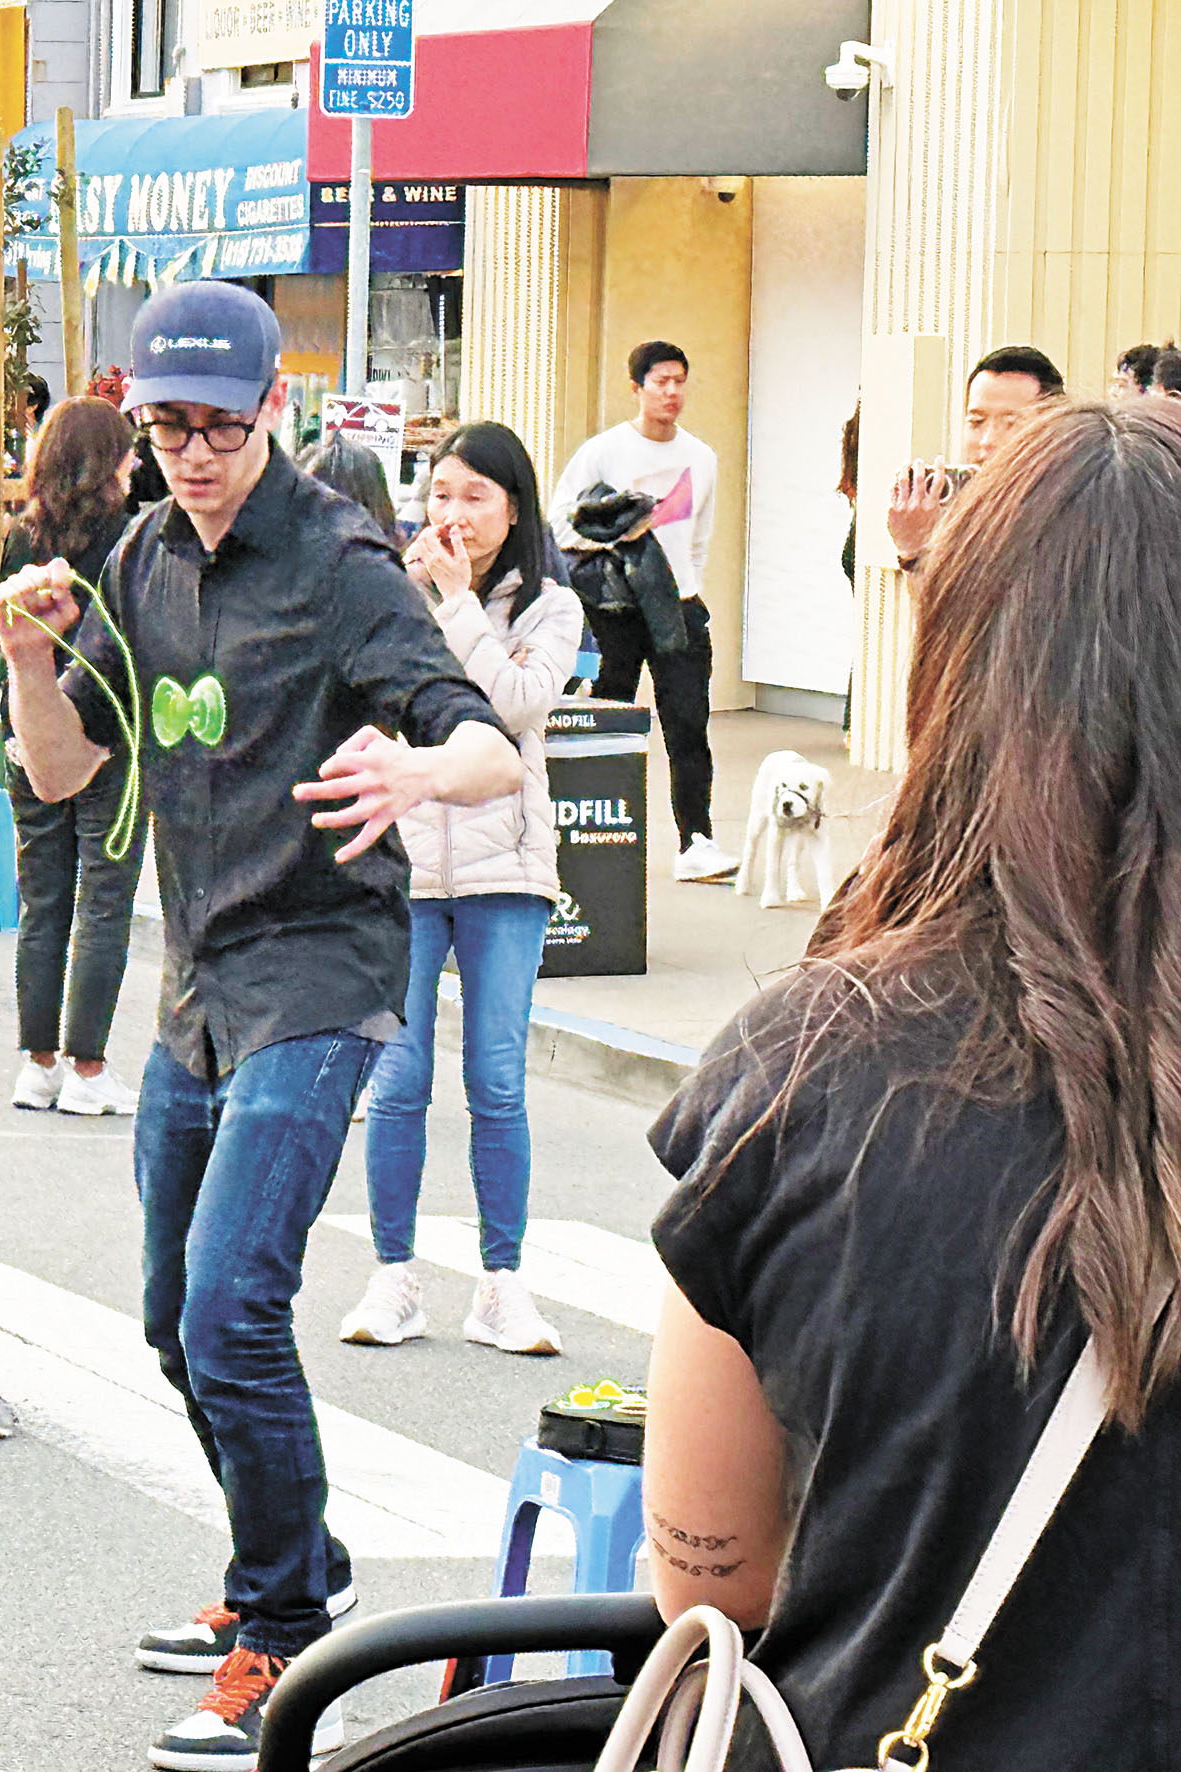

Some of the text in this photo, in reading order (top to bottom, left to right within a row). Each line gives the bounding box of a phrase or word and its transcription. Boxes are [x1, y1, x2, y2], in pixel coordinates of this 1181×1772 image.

[327, 0, 412, 28] PARKING
[343, 29, 394, 57] ONLY
[337, 68, 398, 86] MINIMUM
[329, 90, 406, 109] FINE $250
[245, 158, 303, 192] DISCOUNT
[48, 172, 124, 234] SY
[127, 167, 235, 233] MONEY
[381, 186, 398, 203] &
[403, 185, 458, 203] WINE
[237, 193, 305, 228] CIGARETTES
